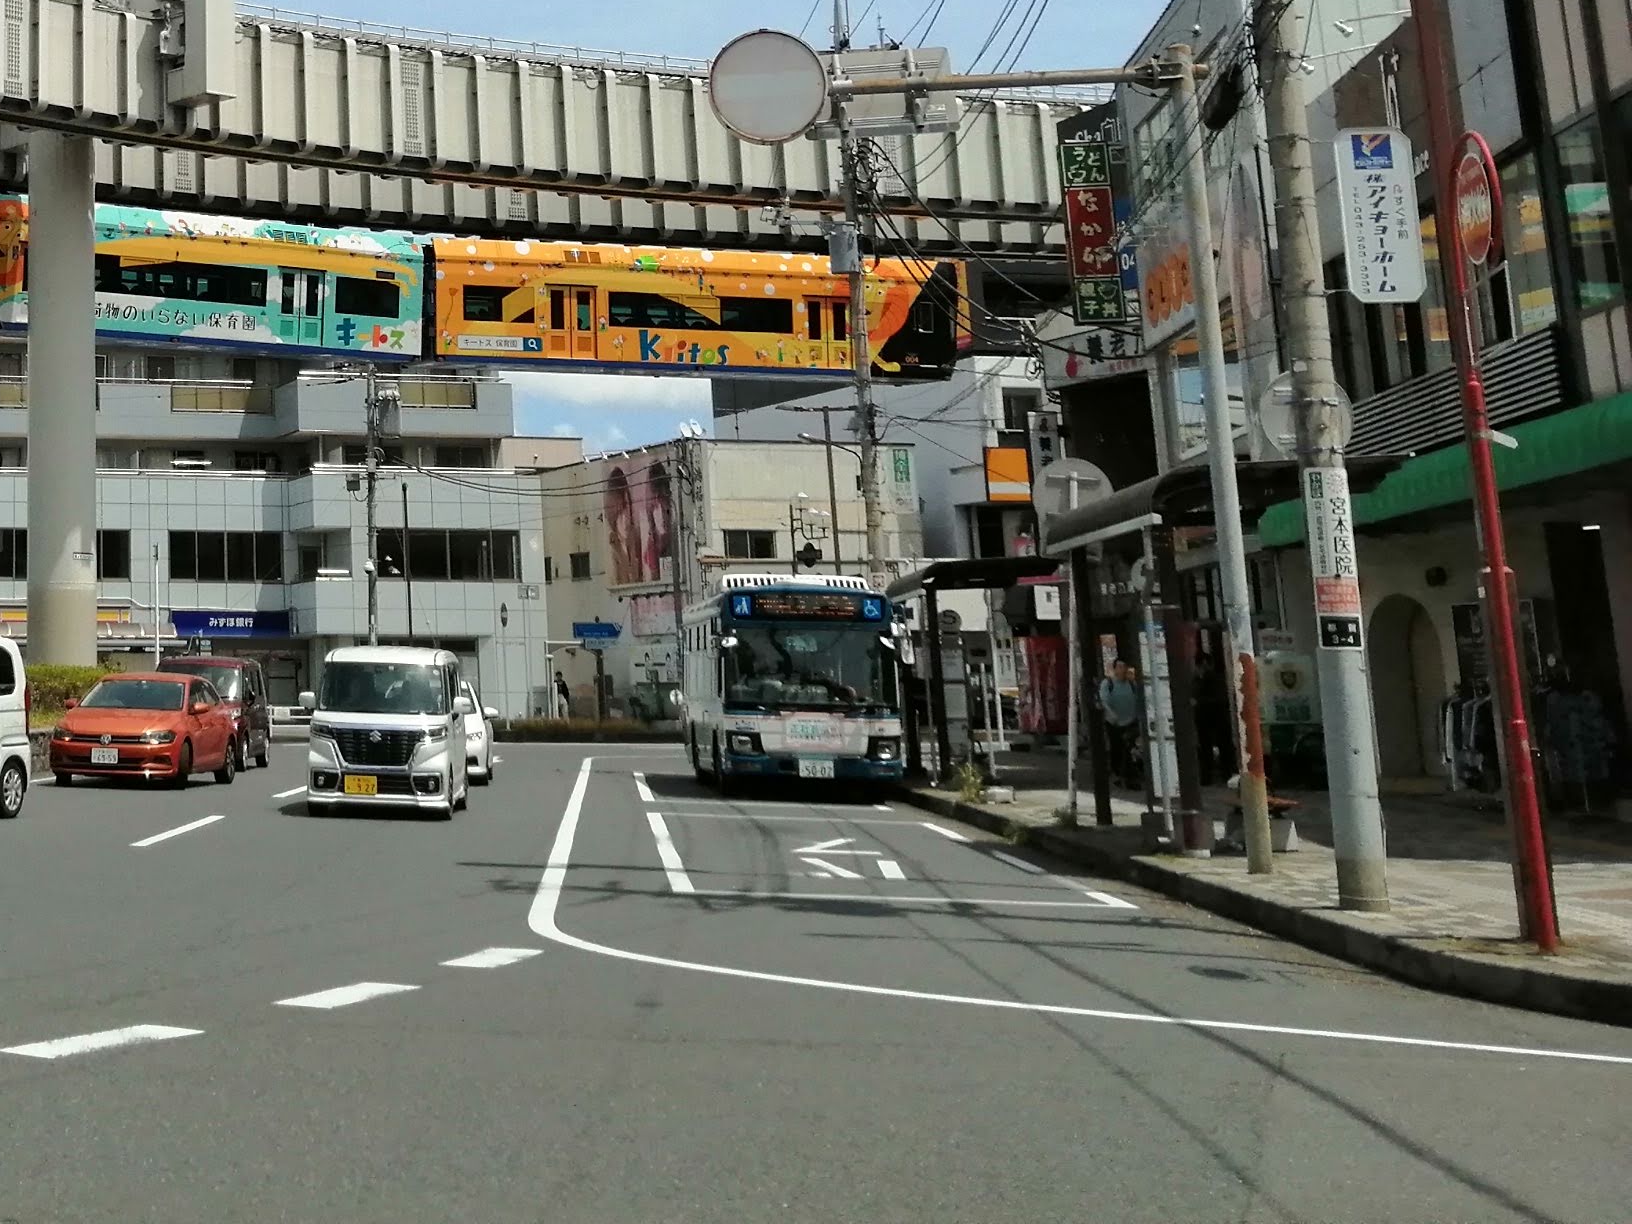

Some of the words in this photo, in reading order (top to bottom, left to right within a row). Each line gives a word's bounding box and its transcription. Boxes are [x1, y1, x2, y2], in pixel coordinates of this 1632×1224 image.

[336, 318, 405, 350] キートス
[639, 329, 730, 365] Kiitos
[1330, 496, 1353, 575] 宮本医院
[208, 617, 254, 627] みずほ銀行
